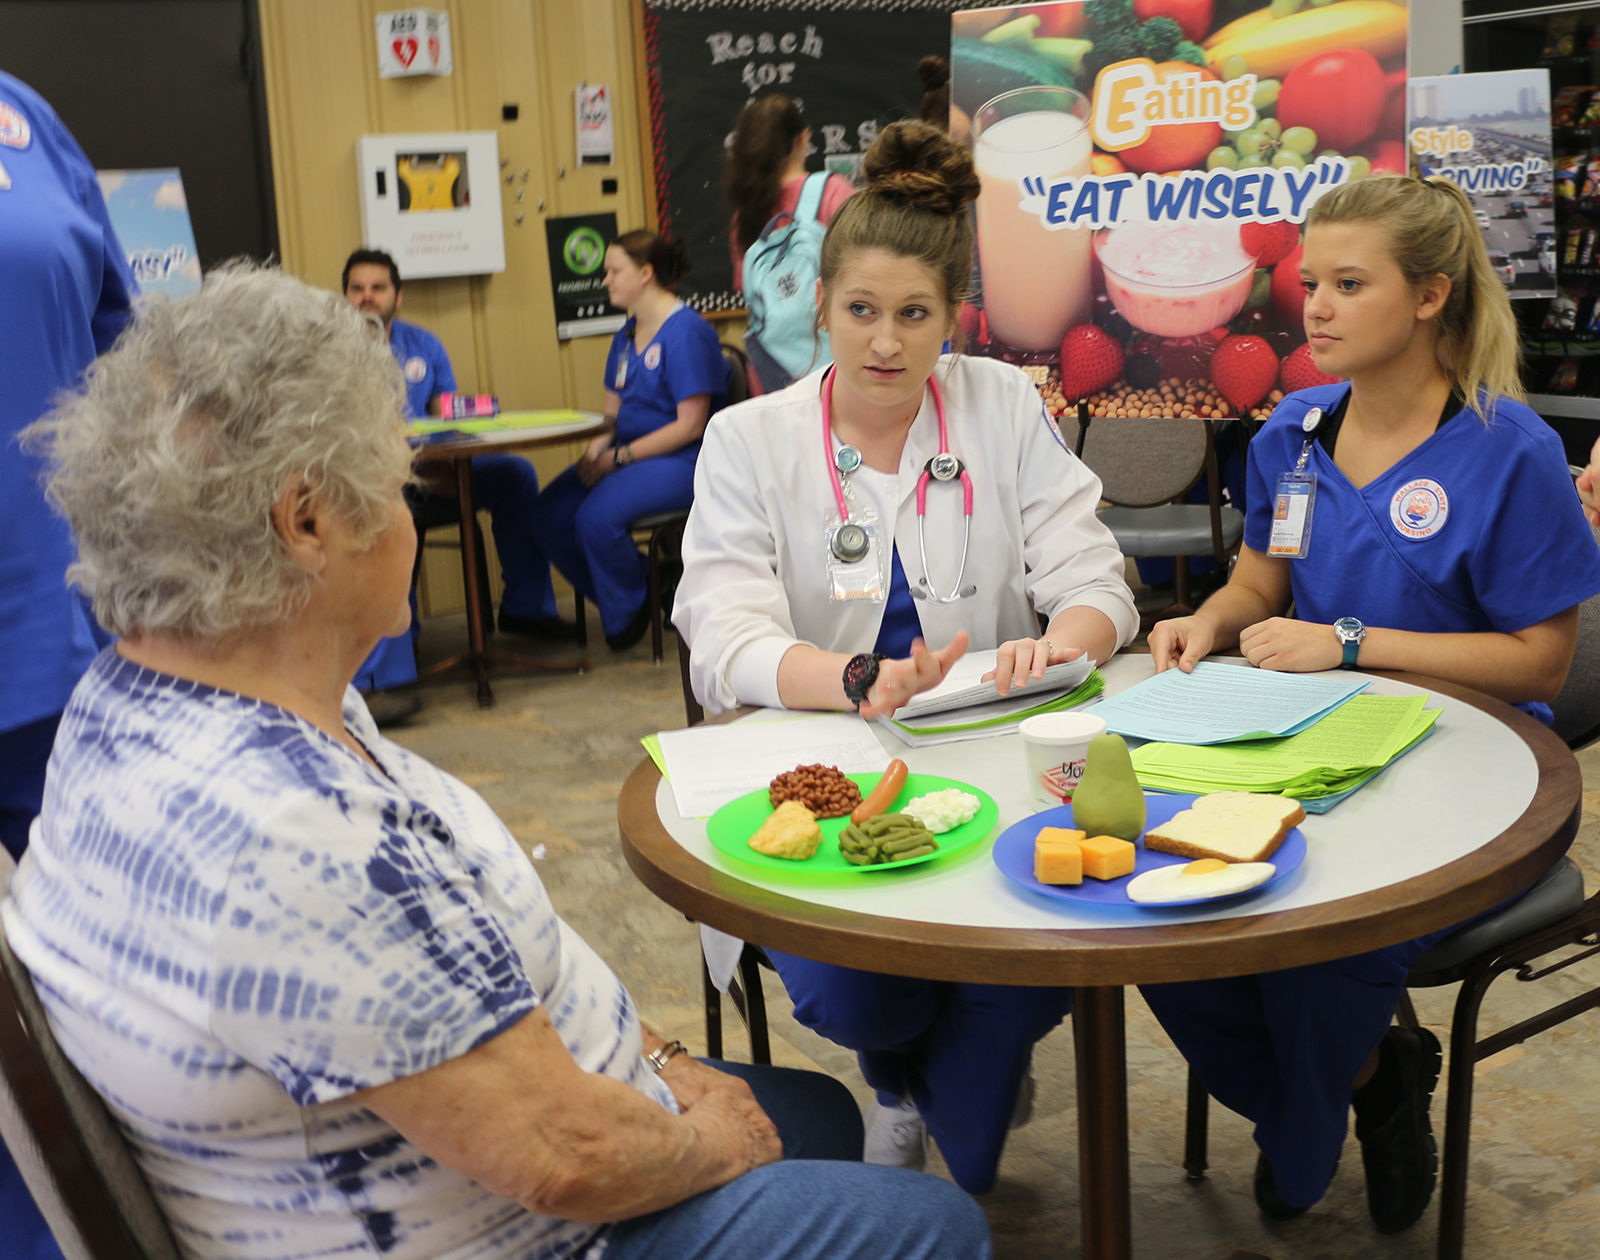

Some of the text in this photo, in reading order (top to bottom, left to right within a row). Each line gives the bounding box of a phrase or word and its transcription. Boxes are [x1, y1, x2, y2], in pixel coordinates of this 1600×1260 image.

[706, 24, 824, 65] Reach
[741, 61, 796, 93] for
[1104, 74, 1253, 135] Eating
[1412, 127, 1472, 155] Style
[1023, 162, 1344, 224] "EAT WISELY"
[1394, 480, 1447, 512] WALLACE STATE
[1395, 519, 1432, 537] NURSING
